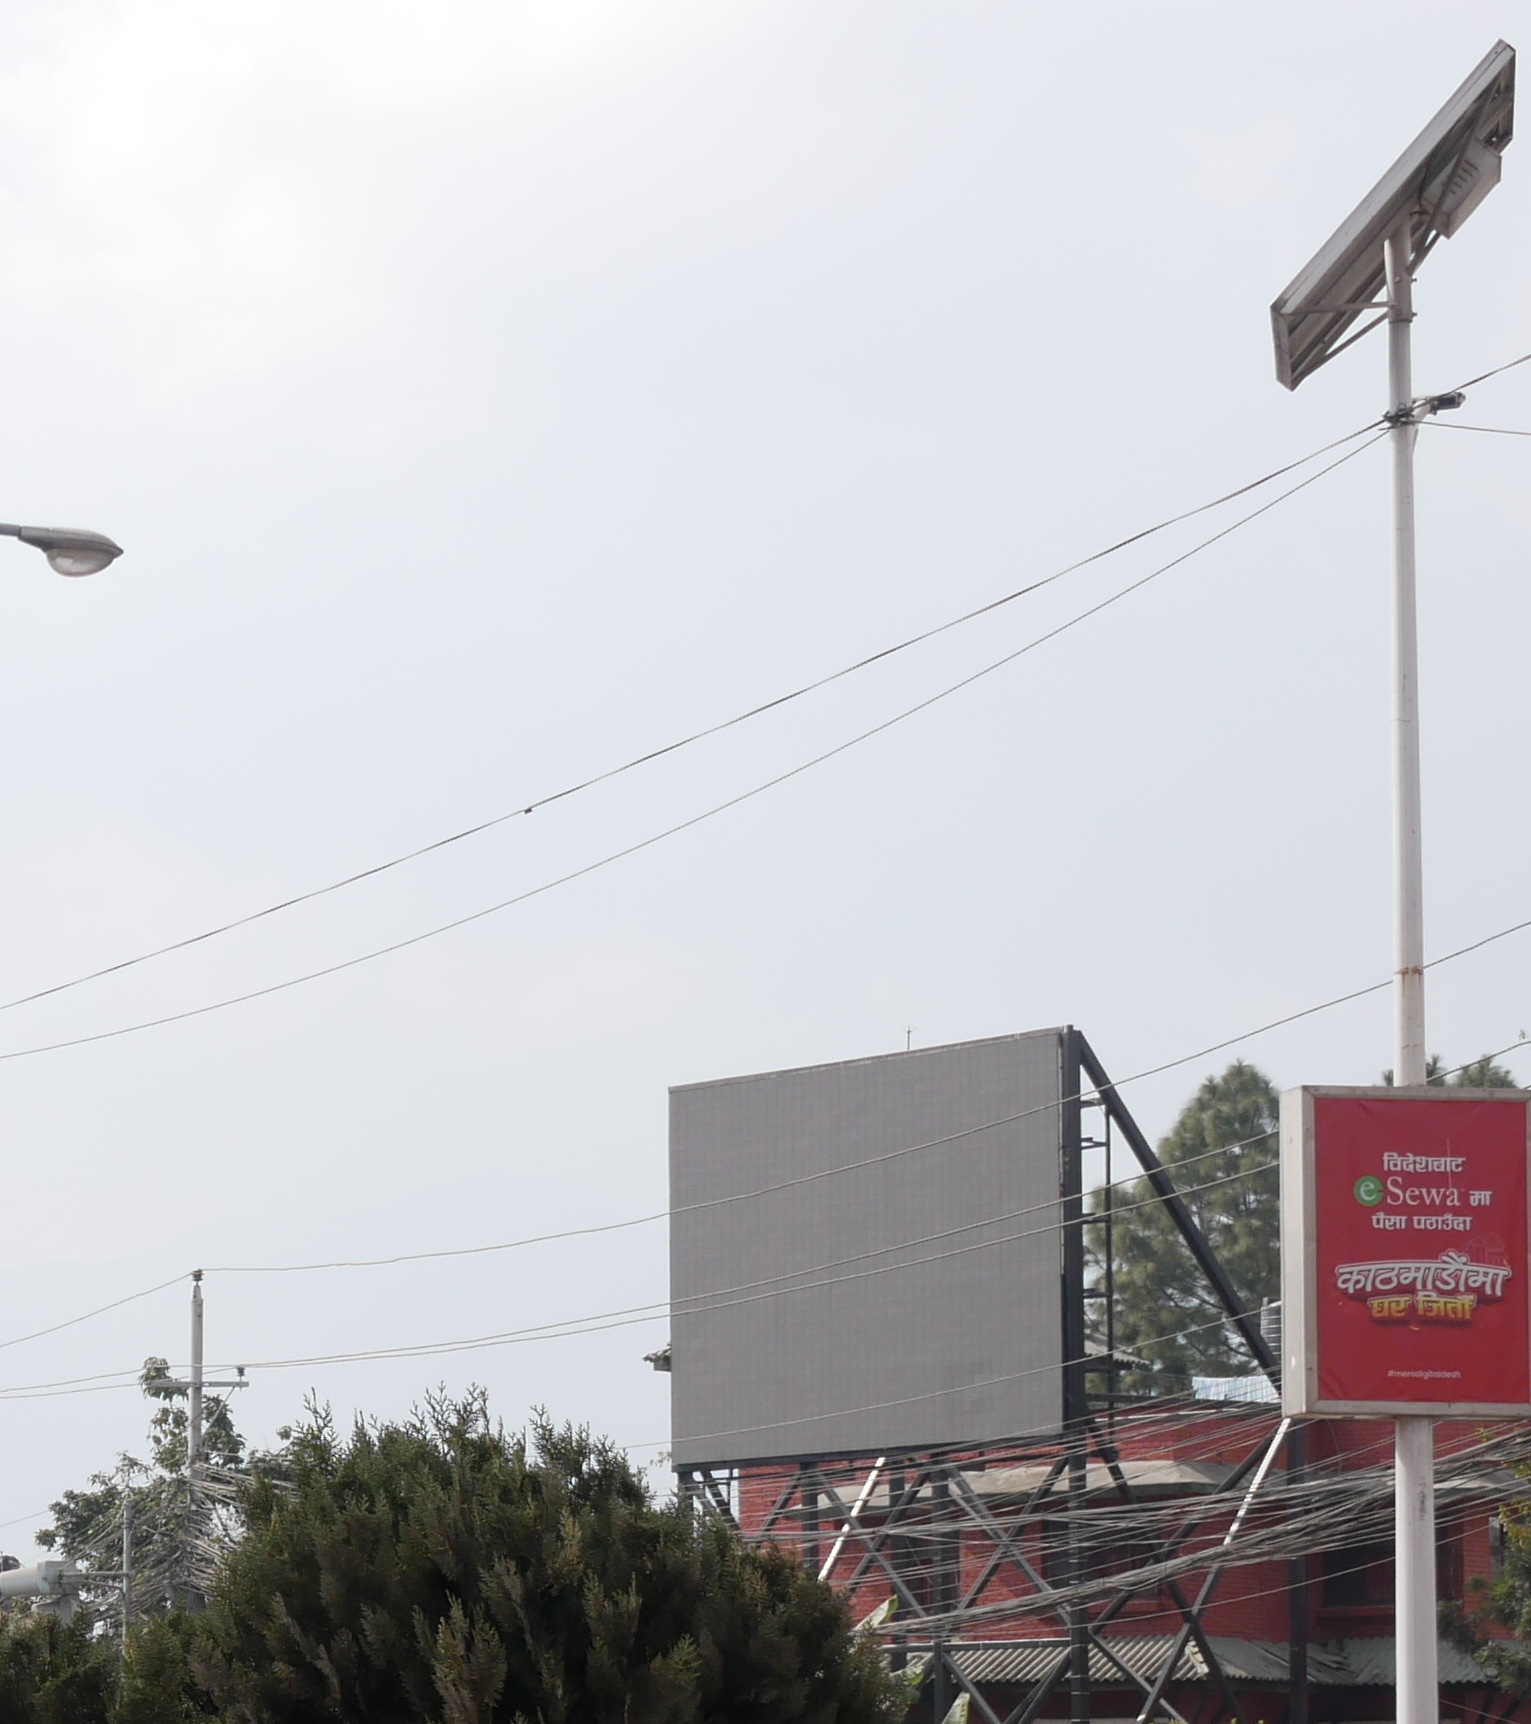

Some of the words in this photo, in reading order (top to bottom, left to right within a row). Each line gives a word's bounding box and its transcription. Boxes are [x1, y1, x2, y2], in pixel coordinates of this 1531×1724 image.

[1383, 1152, 1466, 1173] विदेशबाट
[1469, 1190, 1492, 1206] मा
[1372, 1211, 1408, 1230] पैसा
[1413, 1212, 1472, 1231] पठाउँदा
[1368, 1296, 1412, 1318] घर
[1387, 1370, 1461, 1380] #merodigitaldesh
